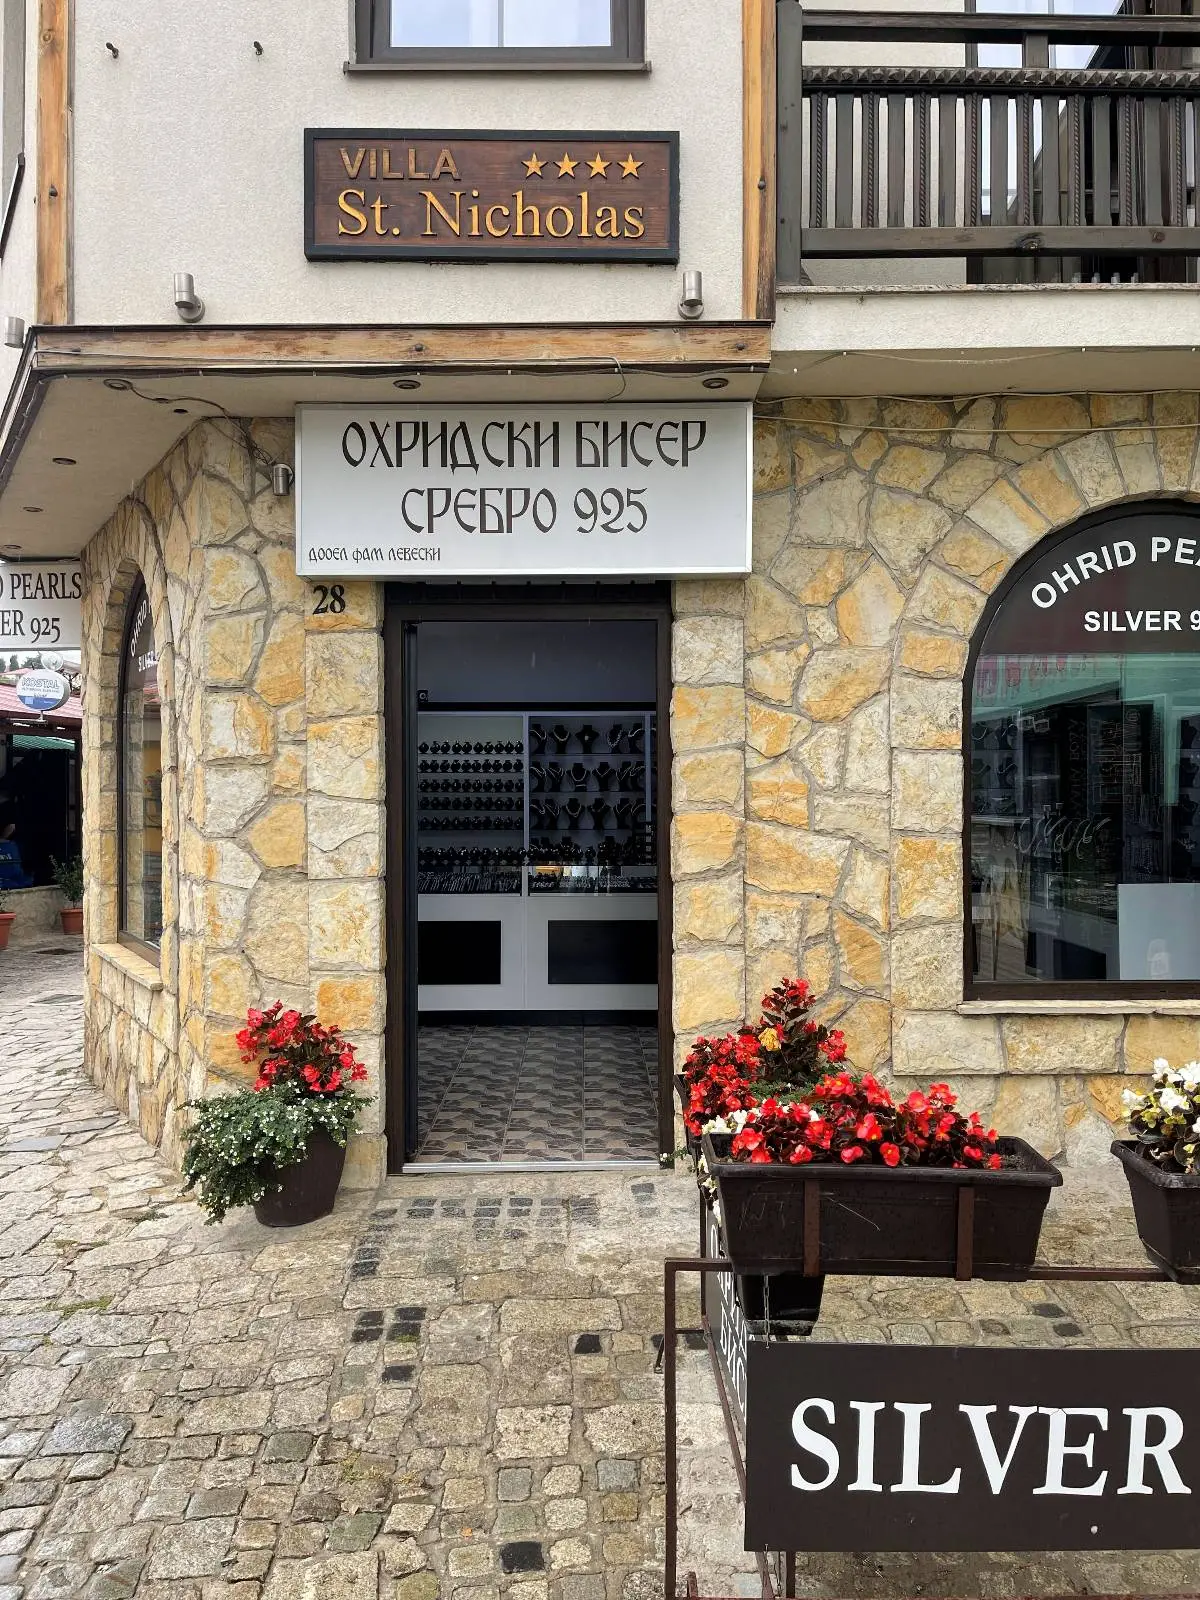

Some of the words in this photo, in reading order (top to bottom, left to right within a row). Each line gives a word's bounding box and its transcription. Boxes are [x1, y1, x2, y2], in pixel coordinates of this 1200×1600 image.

[338, 147, 461, 181] VILLA
[337, 188, 401, 236] St.
[418, 188, 646, 239] Nicholas
[341, 420, 560, 475] ОХРИДСКИ
[575, 420, 707, 468] БИСЕР
[401, 487, 557, 534] СРЕБРО
[573, 487, 649, 534] 925
[9, 572, 83, 600] PEARLS
[1031, 540, 1137, 609] OHRID
[1151, 536, 1200, 567] PE
[312, 584, 346, 615] 28
[30, 617, 61, 644] 925
[1084, 610, 1183, 632] SILVER
[791, 1397, 1192, 1496] SILVER
